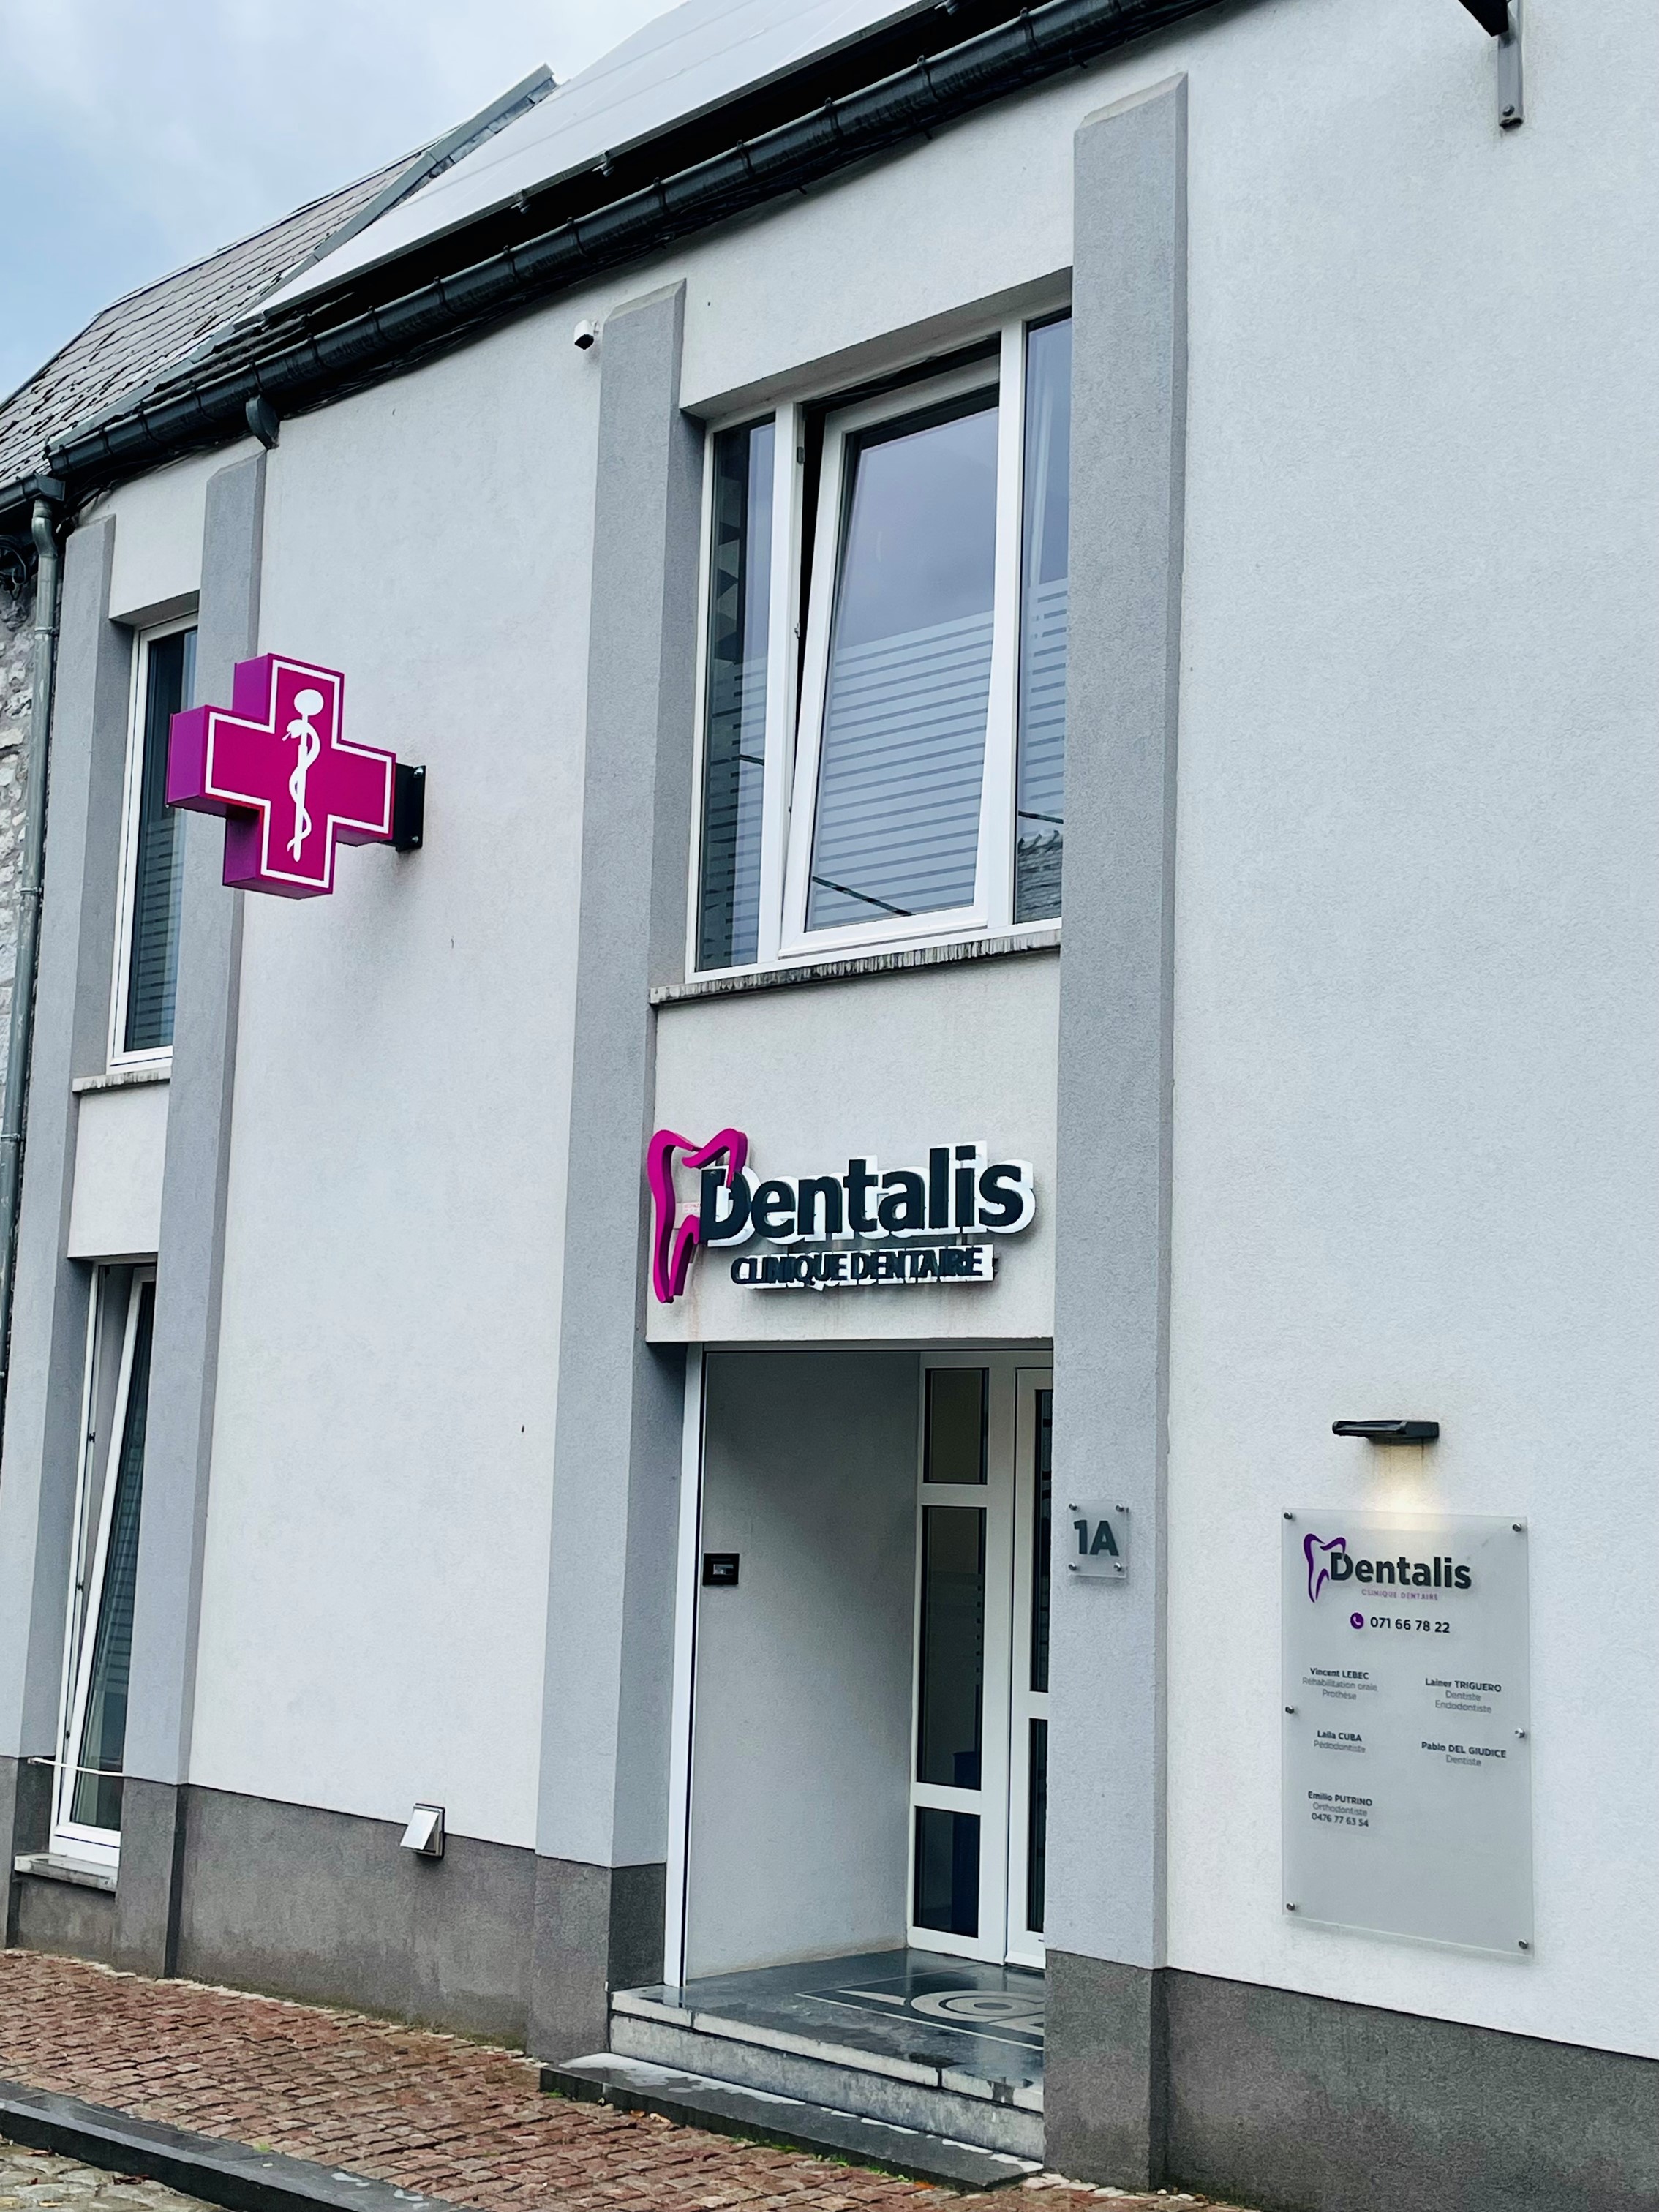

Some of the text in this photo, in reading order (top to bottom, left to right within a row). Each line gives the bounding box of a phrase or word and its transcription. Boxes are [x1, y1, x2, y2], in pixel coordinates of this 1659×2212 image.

[699, 1146, 1024, 1243] Dentalis
[731, 1246, 985, 1285] CLINIQUE DENTAIRE
[1073, 1519, 1120, 1557] 1A
[1330, 1551, 1472, 1590] Dentalis
[1361, 1589, 1439, 1600] CLINIQUE DENTAIRE
[1370, 1617, 1451, 1633] 071 66 78 22
[1309, 1667, 1369, 1680] Vincent LEBEC
[1454, 1679, 1502, 1693] TRIGUERO
[1445, 1690, 1481, 1701] Dentiste
[1434, 1699, 1492, 1713] Endodontiste
[1338, 1732, 1363, 1742] CUBA
[1421, 1741, 1507, 1758] Pablo DEL GIUDICE
[1445, 1754, 1482, 1767] Dentiste
[1334, 1794, 1373, 1807] PUTRINO
[1312, 1802, 1368, 1817] Orthodontiste
[1311, 1812, 1333, 1823] 0476
[1334, 1815, 1344, 1824] 77
[1347, 1816, 1357, 1826] 63
